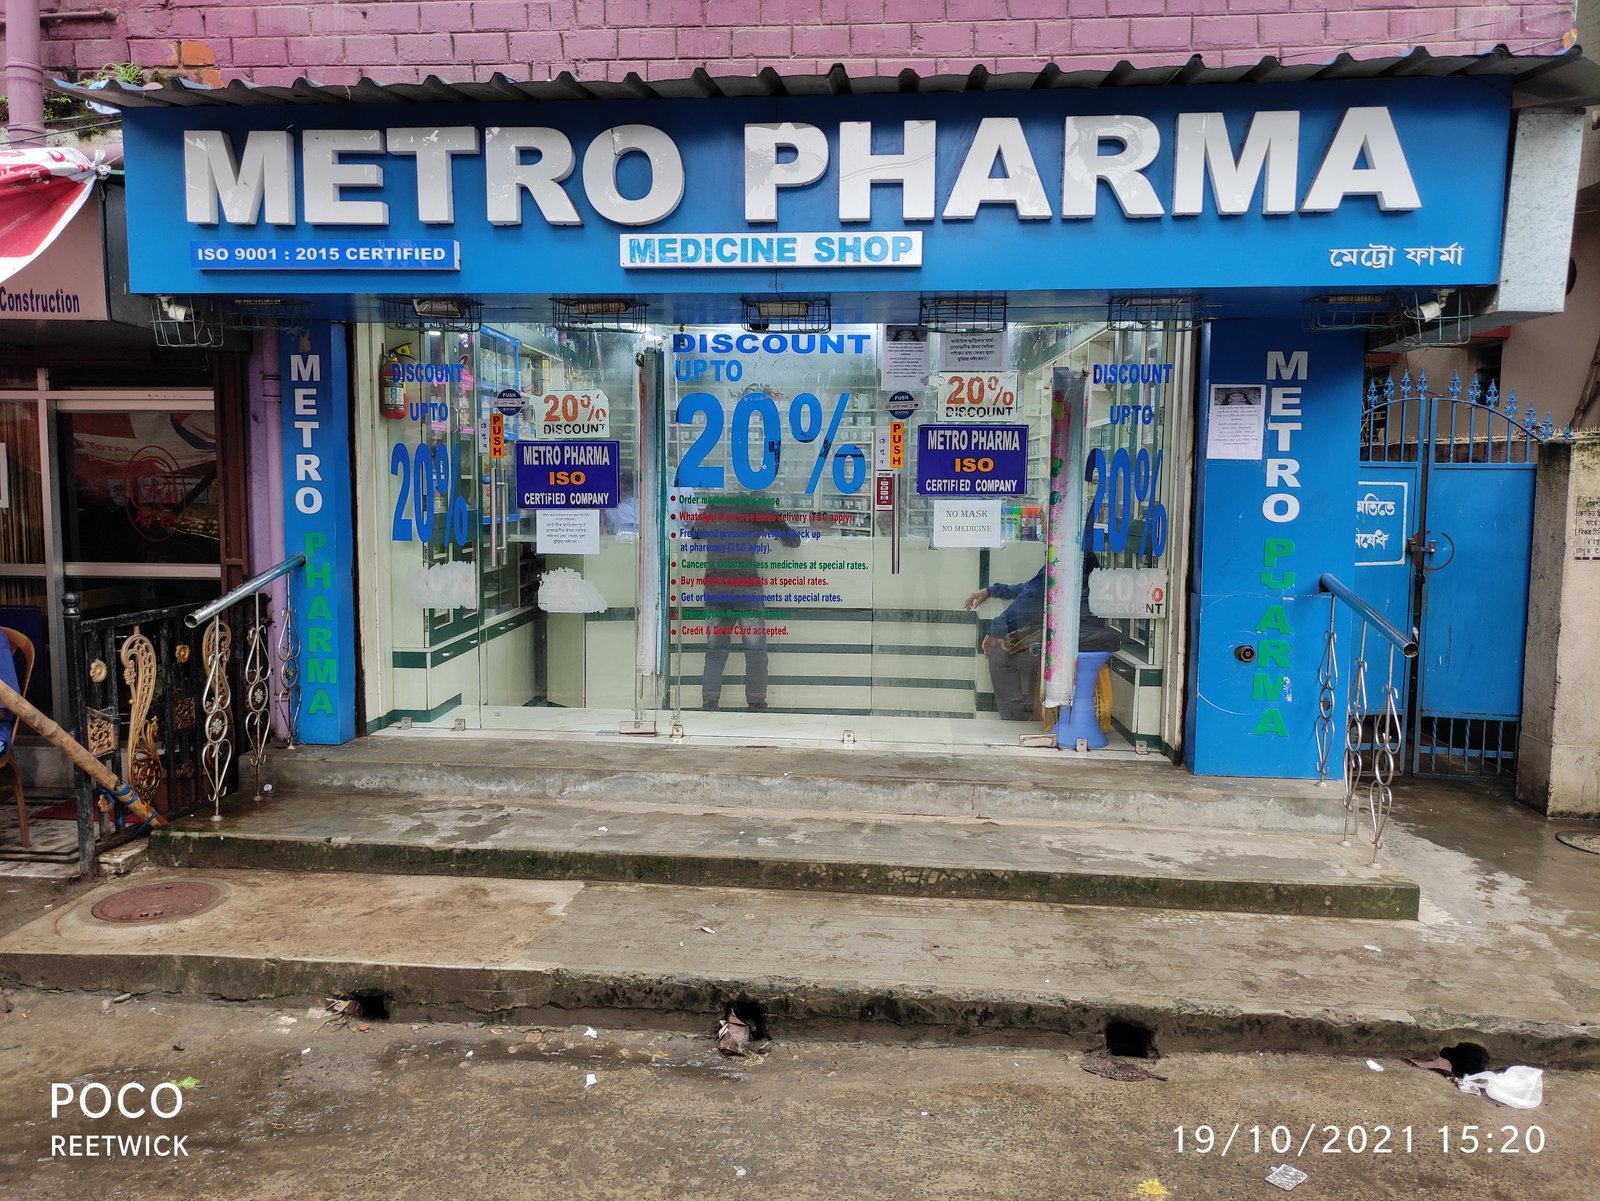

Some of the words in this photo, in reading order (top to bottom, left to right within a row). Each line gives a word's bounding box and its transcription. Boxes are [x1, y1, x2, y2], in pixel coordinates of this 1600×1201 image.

[183, 124, 685, 226] METRO
[744, 106, 1423, 224] PHARMA
[198, 248, 229, 261] ISO
[235, 248, 277, 260] 9001
[296, 247, 340, 260] 2015
[346, 247, 446, 260] CERTIFIED
[629, 237, 797, 263] MEDICINE
[814, 236, 913, 262] SHOP
[1329, 243, 1396, 269] মেট্রো
[1404, 242, 1465, 266] ফার্মা
[0, 287, 80, 313] Construction
[672, 334, 871, 354] DISCOUNT
[391, 363, 465, 383] DISCOUNT
[675, 360, 743, 382] UPTO
[1093, 363, 1173, 384] DISCOUNT
[947, 375, 1014, 406] 20%
[410, 402, 448, 421] UPTO
[543, 394, 607, 422] 20%
[946, 407, 1013, 418] DISCOUNT
[1110, 405, 1153, 425] UPTO
[290, 354, 323, 515] METRO
[493, 416, 502, 456] PUSH
[544, 423, 605, 434] DISCOUNT
[1261, 351, 1309, 523] METRO
[674, 392, 866, 494] 20%
[893, 423, 902, 465] PUSH
[928, 430, 968, 451] METRO
[971, 430, 1020, 451] PHARMA
[523, 445, 561, 465] METRO
[564, 446, 610, 466] PHARMA
[955, 458, 994, 472] ISO
[549, 471, 586, 485] ISO
[925, 479, 970, 492] CERTIFIED
[975, 479, 1017, 492] COMPANY
[391, 441, 468, 548] 20%
[524, 493, 566, 505] CERTIFIED
[570, 493, 609, 505] COMPANY
[679, 495, 700, 505] Order
[1082, 448, 1167, 558] 20%
[679, 512, 716, 523] WhatsApp
[778, 513, 807, 523] delivery
[946, 510, 958, 518] NO
[961, 510, 988, 518] MASK
[760, 530, 783, 539] weig
[811, 531, 821, 540] up
[680, 543, 688, 551] at
[689, 543, 725, 554] pharmacy
[681, 560, 707, 570] Cancer
[770, 560, 808, 569] medicines
[809, 561, 818, 569] at
[819, 560, 845, 571] special
[847, 561, 869, 570] rates.
[680, 576, 695, 590] Buy
[770, 577, 778, 585] at
[780, 577, 806, 588] special
[807, 577, 828, 586] rates.
[680, 592, 694, 602] Get
[784, 593, 792, 602] at
[794, 593, 819, 604] special
[821, 593, 843, 602] rates.
[304, 531, 336, 715] PHARMA
[682, 626, 703, 635] Credit
[705, 626, 711, 635] &
[734, 626, 751, 635] Card
[753, 626, 789, 637] accepted.
